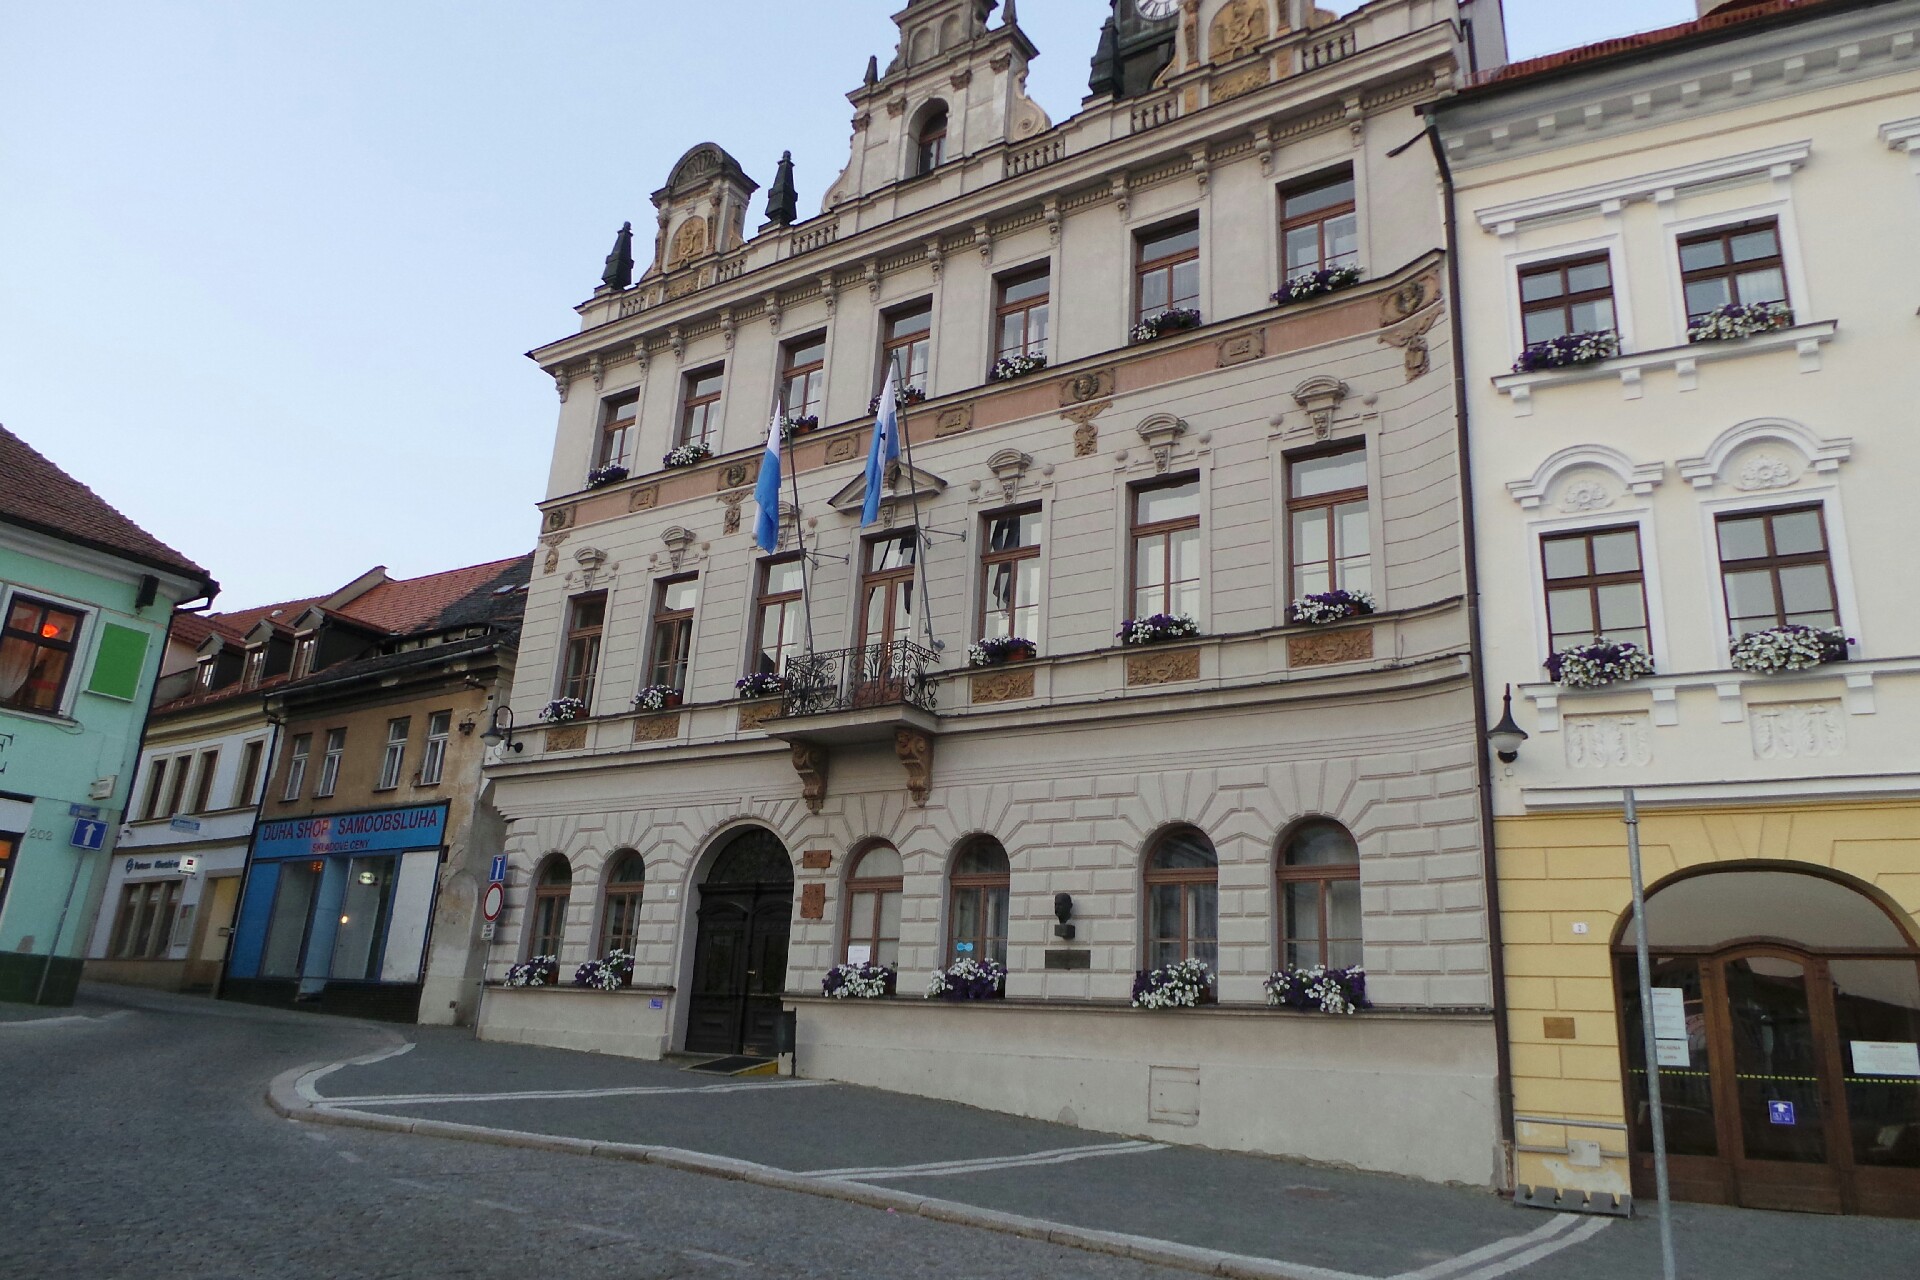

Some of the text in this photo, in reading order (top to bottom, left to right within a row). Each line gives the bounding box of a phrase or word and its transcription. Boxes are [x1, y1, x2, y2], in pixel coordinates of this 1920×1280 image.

[263, 809, 437, 841] DUHA SHOP SAMOOBSLUHA
[29, 828, 53, 841] 202
[350, 839, 369, 850] CENY
